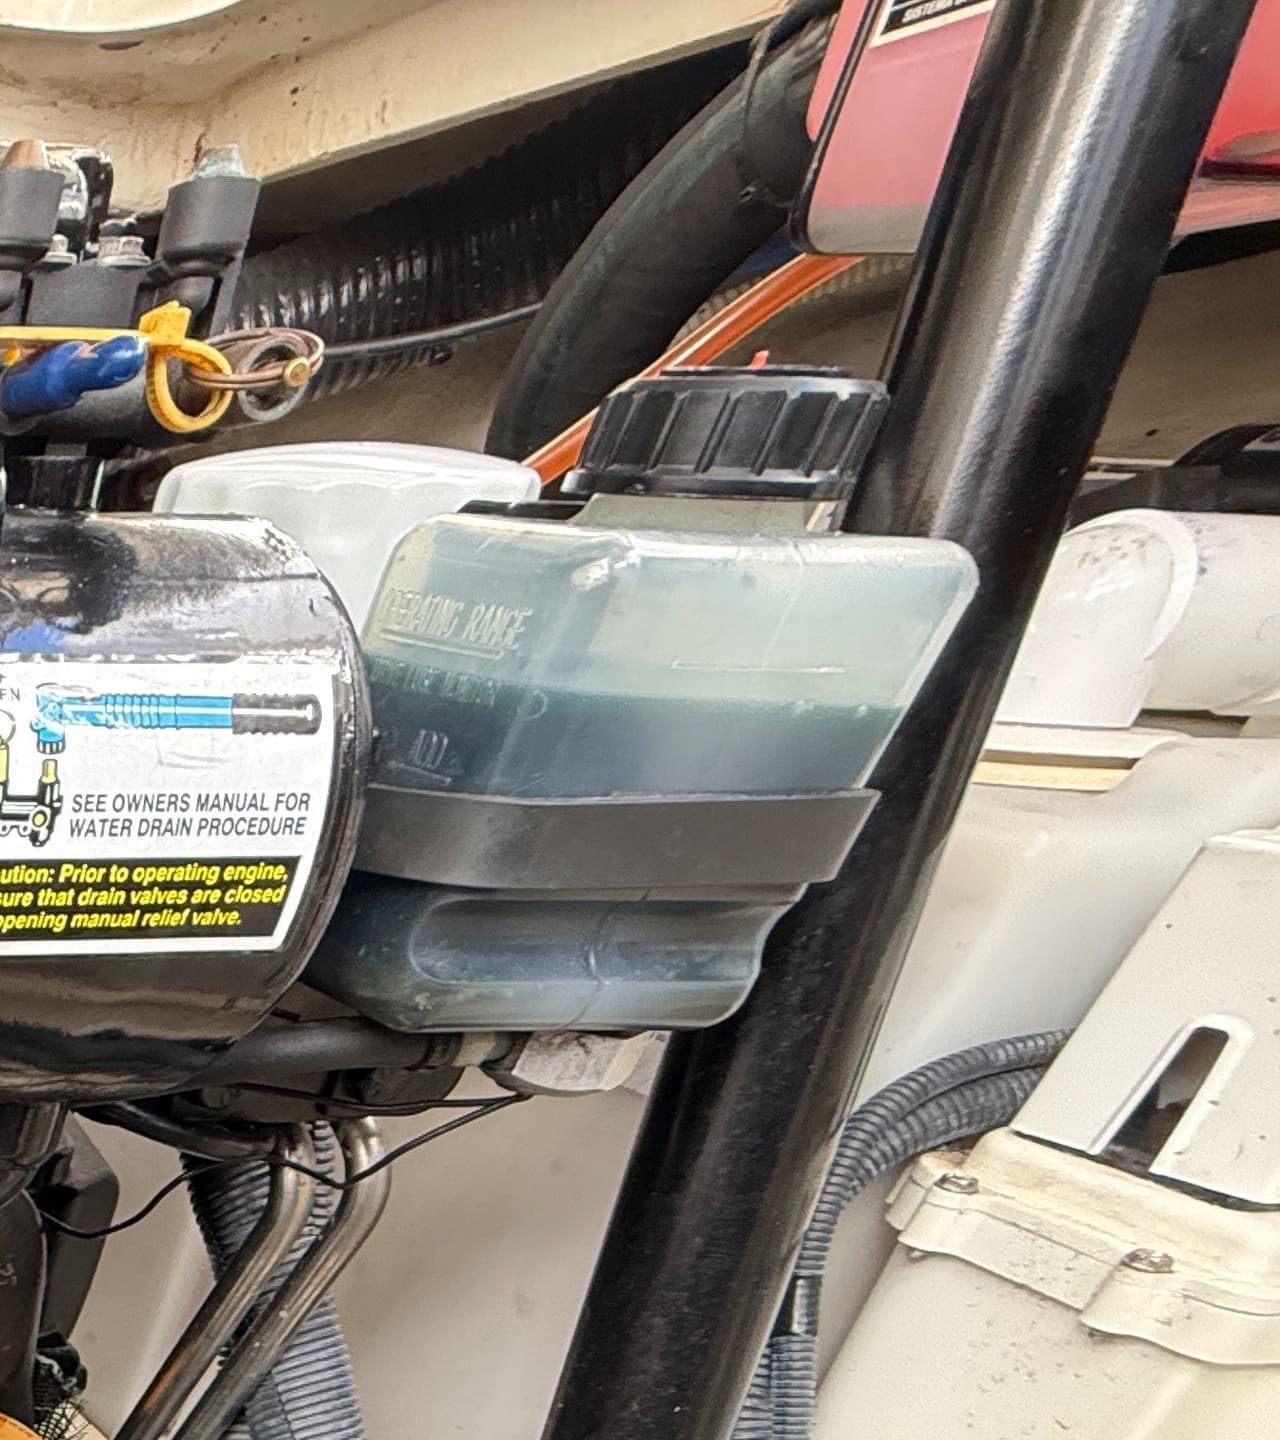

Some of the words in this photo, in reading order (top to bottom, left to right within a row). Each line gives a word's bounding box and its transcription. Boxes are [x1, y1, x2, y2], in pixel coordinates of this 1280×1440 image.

[463, 603, 534, 650] RANGE
[71, 793, 108, 813] SEE
[112, 793, 191, 813] OWNERS
[195, 792, 270, 812] MANUAL
[274, 792, 311, 812] FOR
[69, 818, 133, 838] WATER
[137, 817, 194, 837] DRAIN
[197, 816, 308, 836] PROCEDURE
[58, 863, 106, 883] Prior
[108, 864, 130, 883] to
[132, 862, 219, 886] operating
[222, 861, 289, 884] engine,
[36, 887, 75, 907] that
[77, 887, 127, 906] drain
[130, 886, 188, 905] valves
[190, 889, 222, 904] are
[224, 884, 288, 904] closed
[70, 909, 140, 928] manual
[140, 908, 190, 927] relief
[191, 908, 243, 926] valve.
